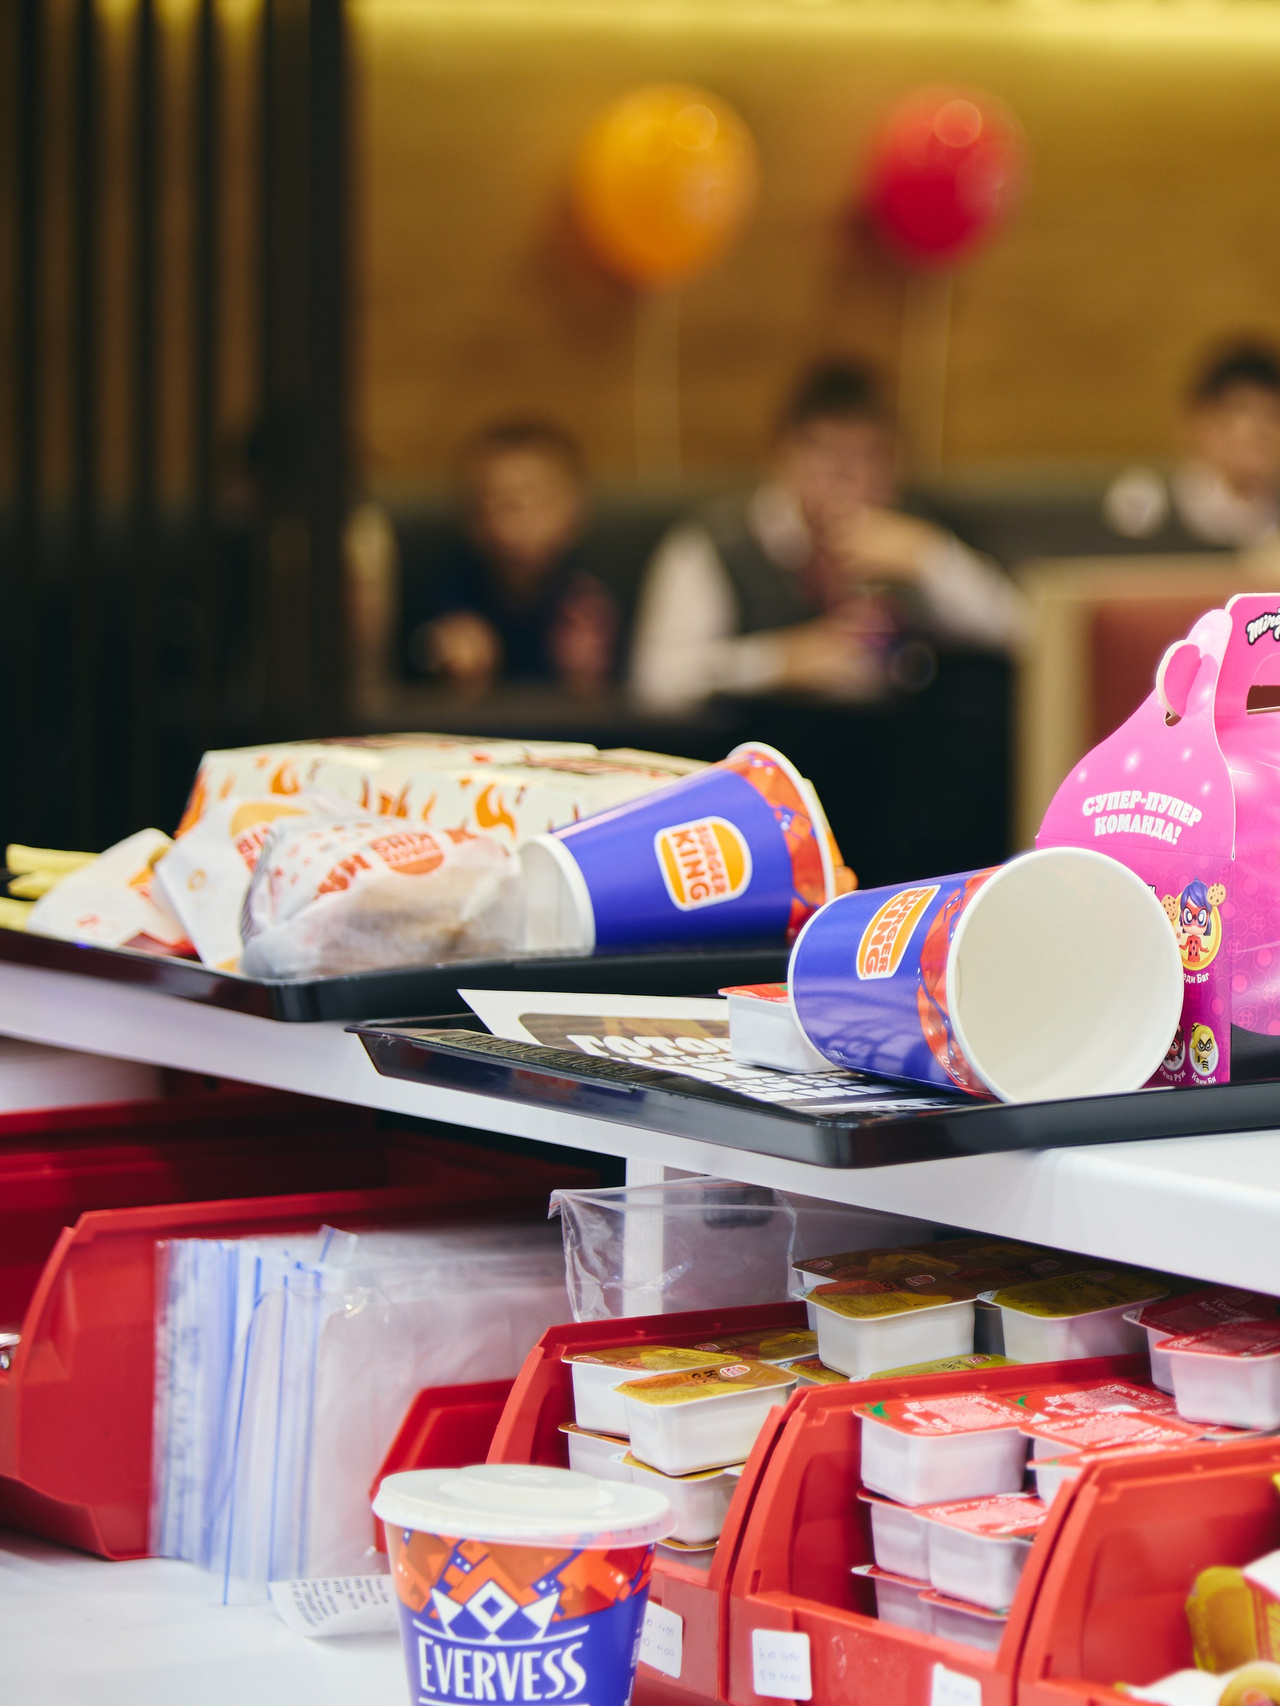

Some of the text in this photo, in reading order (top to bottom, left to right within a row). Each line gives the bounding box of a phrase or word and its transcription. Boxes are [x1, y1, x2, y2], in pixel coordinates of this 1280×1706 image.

[1082, 790, 1203, 827] СУПЕР-ПУПЕР
[1094, 813, 1183, 845] КОМАНДА!
[672, 830, 710, 901] KING
[865, 889, 920, 975] KING
[878, 888, 930, 973] BURGER
[1196, 972, 1210, 984] Баг
[418, 1635, 589, 1702] EVERVESS
